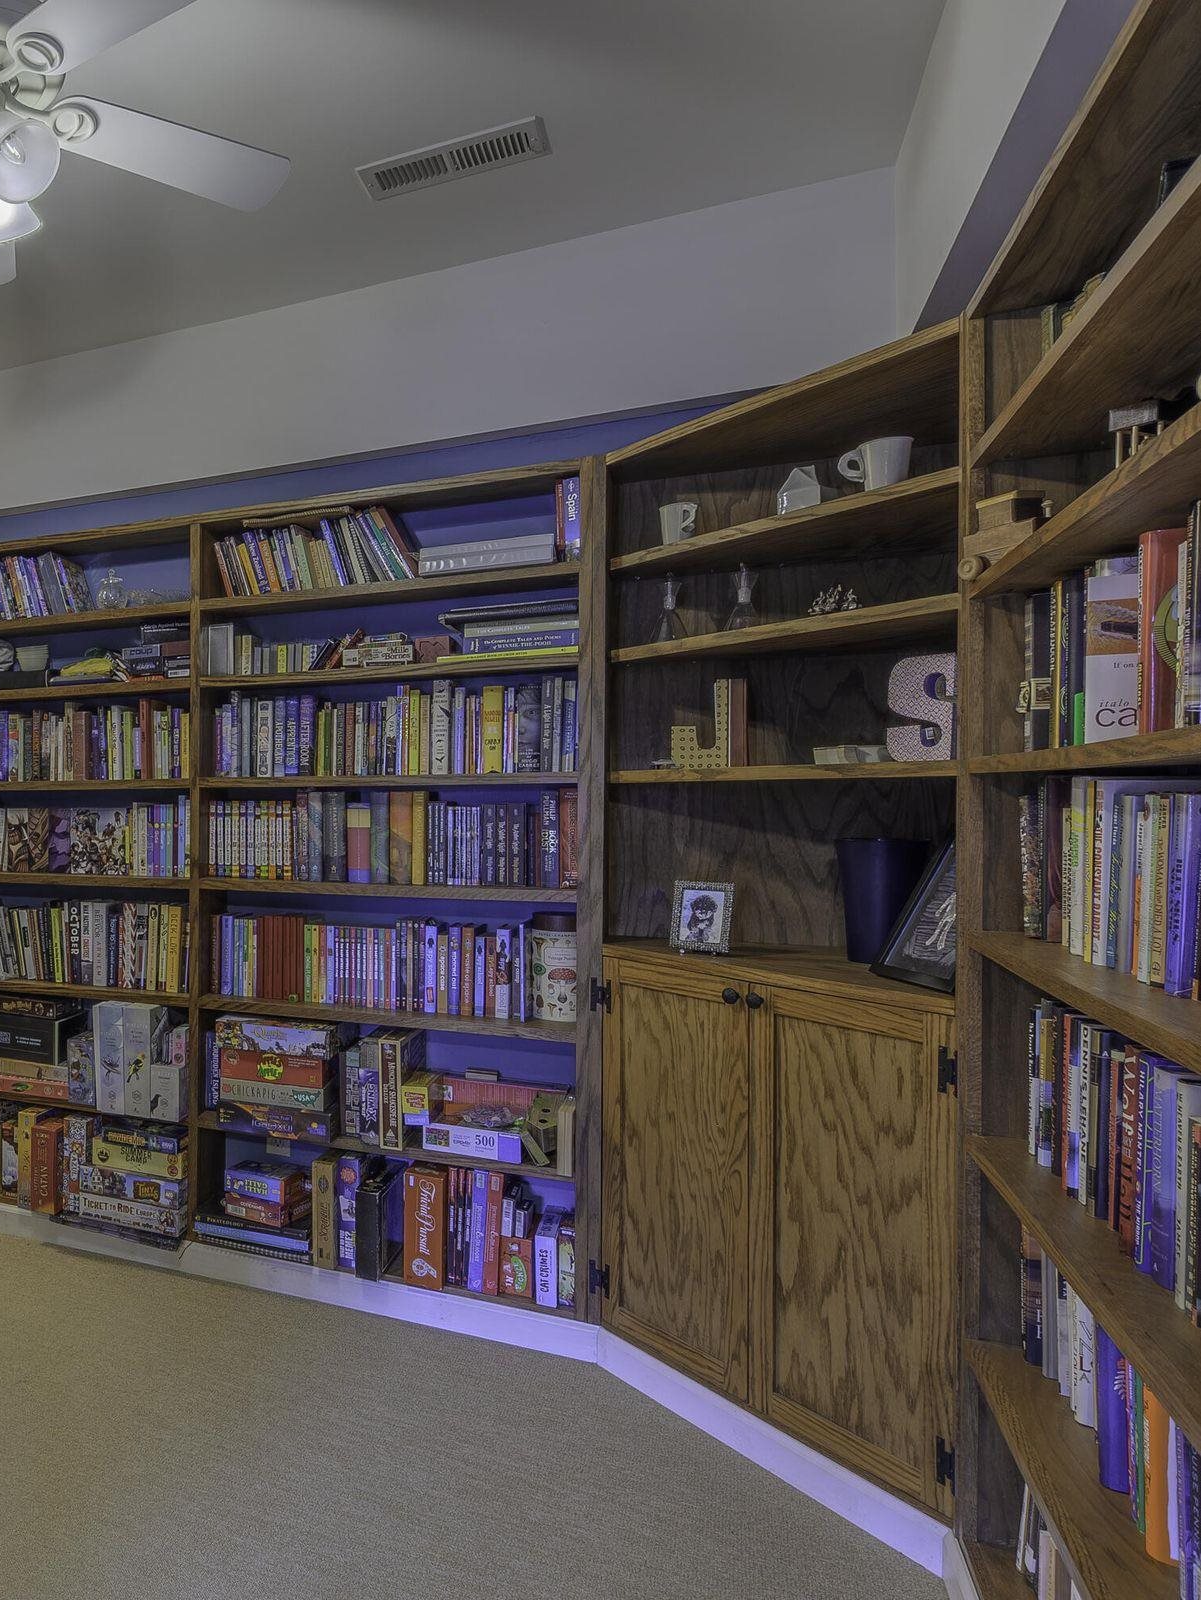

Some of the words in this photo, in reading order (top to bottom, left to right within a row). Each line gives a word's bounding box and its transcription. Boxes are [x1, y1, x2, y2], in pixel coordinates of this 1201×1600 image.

[568, 491, 578, 521] Spain
[249, 543, 257, 556] New
[253, 556, 263, 579] Zealand
[389, 646, 409, 654] Mille
[1099, 699, 1130, 708] italo
[275, 721, 283, 764] APOTHECARY
[286, 721, 295, 766] APPRENTICES
[549, 830, 557, 853] BOOK
[1071, 832, 1080, 868] JASPER
[1156, 851, 1164, 887] WOMAN
[1153, 903, 1165, 927] DIED
[1152, 940, 1162, 955] LOT
[1154, 929, 1163, 938] A
[427, 965, 435, 986] school
[1080, 1026, 1089, 1091] DENNIS
[232, 1086, 276, 1100] CHICKAPIG
[298, 1094, 311, 1102] USA
[1121, 1055, 1136, 1136] Wolf
[1137, 1071, 1146, 1117] HILARY
[475, 1134, 495, 1147] 500
[1079, 1095, 1087, 1163] LEHANE
[1152, 1091, 1163, 1193] MATTERHORN
[121, 1147, 152, 1160] SUMMER
[126, 1156, 147, 1164] CAMP
[1135, 1123, 1143, 1172] MANTEL
[40, 1166, 48, 1197] CATAN
[83, 1197, 107, 1209] TICKET
[117, 1203, 135, 1215] RIDE
[419, 1179, 436, 1216] Trivial
[418, 1215, 435, 1255] Pursuit
[540, 1249, 548, 1278] CRIMES
[540, 1280, 548, 1292] CAT
